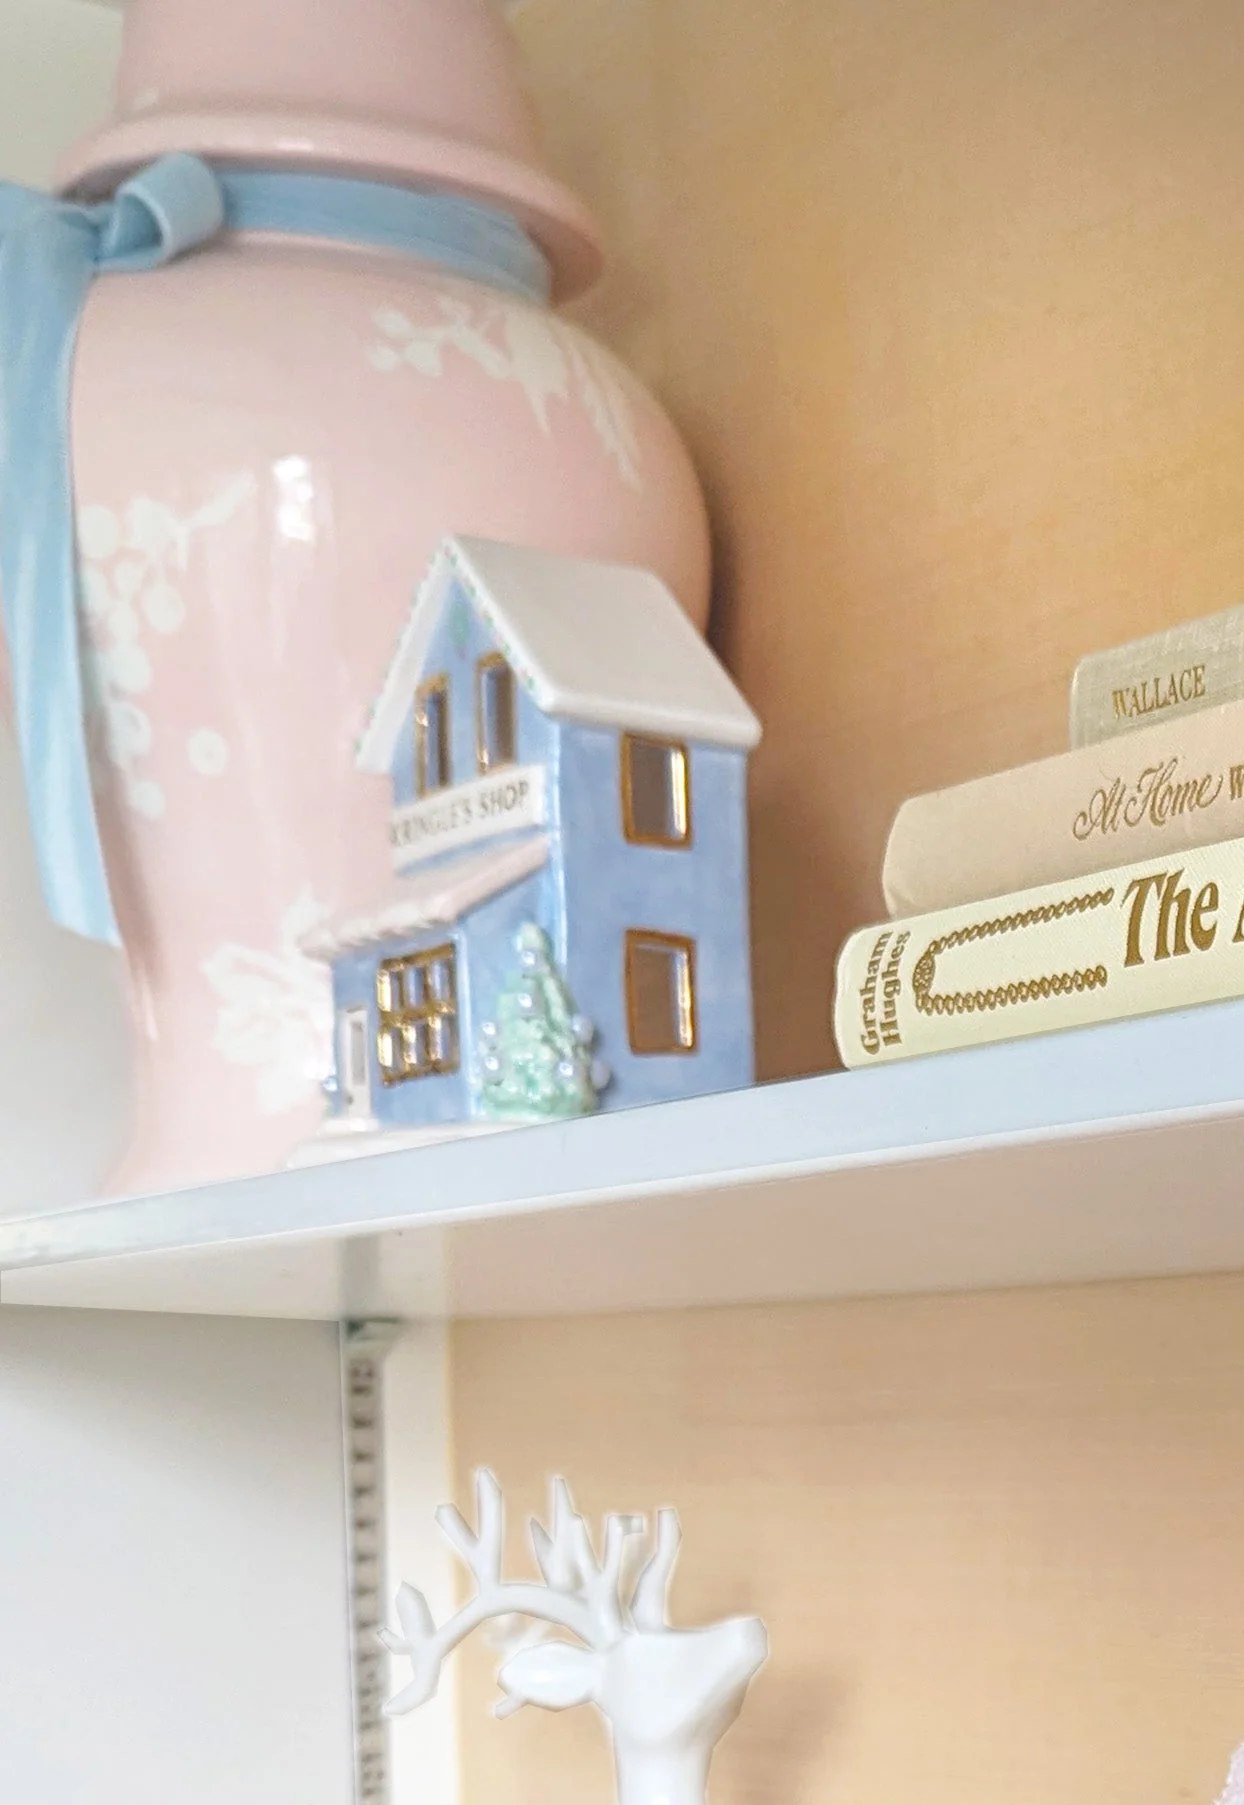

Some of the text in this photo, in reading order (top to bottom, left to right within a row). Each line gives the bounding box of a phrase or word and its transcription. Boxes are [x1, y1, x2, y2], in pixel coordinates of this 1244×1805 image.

[1112, 664, 1206, 721] WALLACE
[479, 780, 530, 819] SHOP
[1073, 777, 1127, 840] At
[1124, 757, 1223, 827] Home
[1119, 866, 1220, 968] The
[860, 931, 893, 1055] Graham
[880, 930, 911, 1046] Hughes
